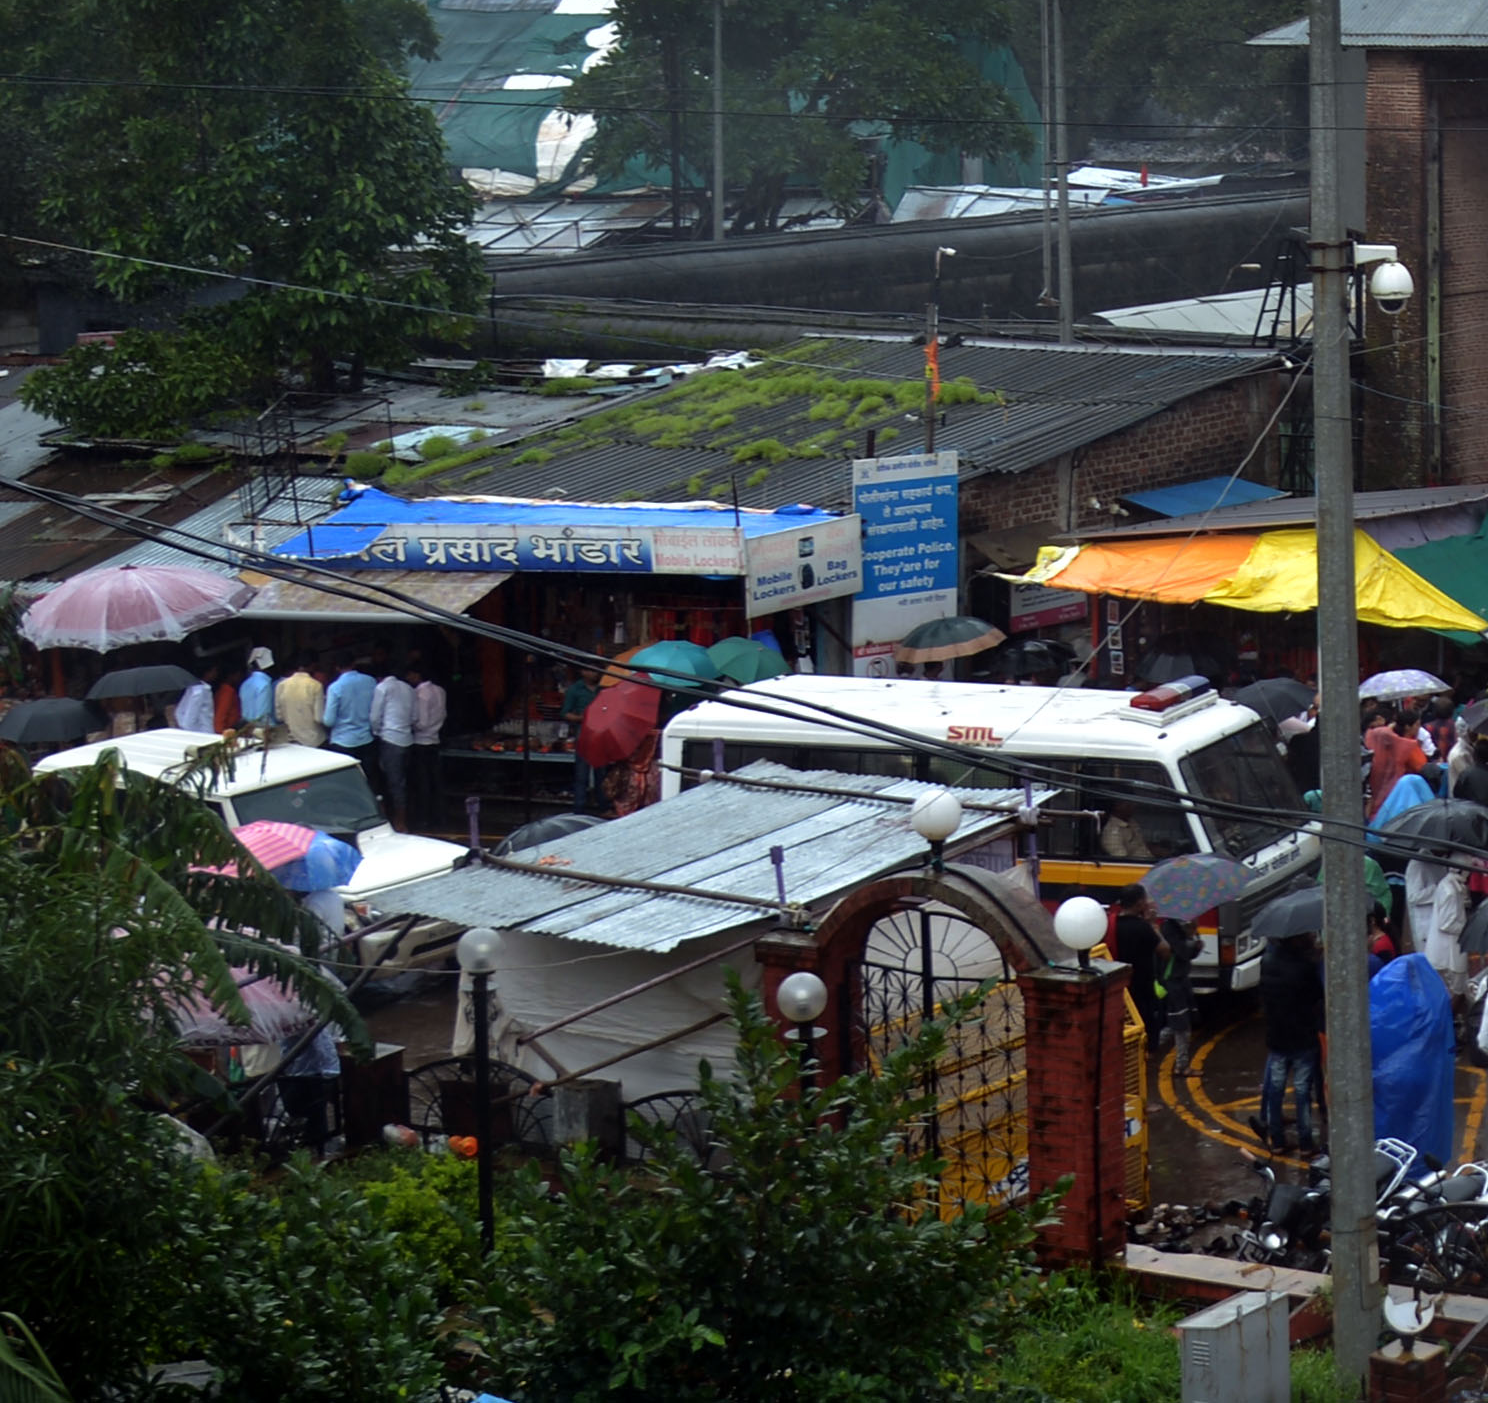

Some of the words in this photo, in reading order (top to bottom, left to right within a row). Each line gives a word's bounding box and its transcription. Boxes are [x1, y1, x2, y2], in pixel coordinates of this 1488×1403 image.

[419, 536, 518, 566] प्रसाद
[531, 527, 644, 566] भांडार
[655, 553, 690, 567] Mobile
[827, 559, 848, 572] Bag
[924, 558, 940, 570] for
[756, 571, 793, 586] Mobile
[817, 569, 858, 586] Lockers
[900, 576, 935, 589] safety
[753, 583, 797, 601] Lockers
[947, 725, 1004, 741] SML
